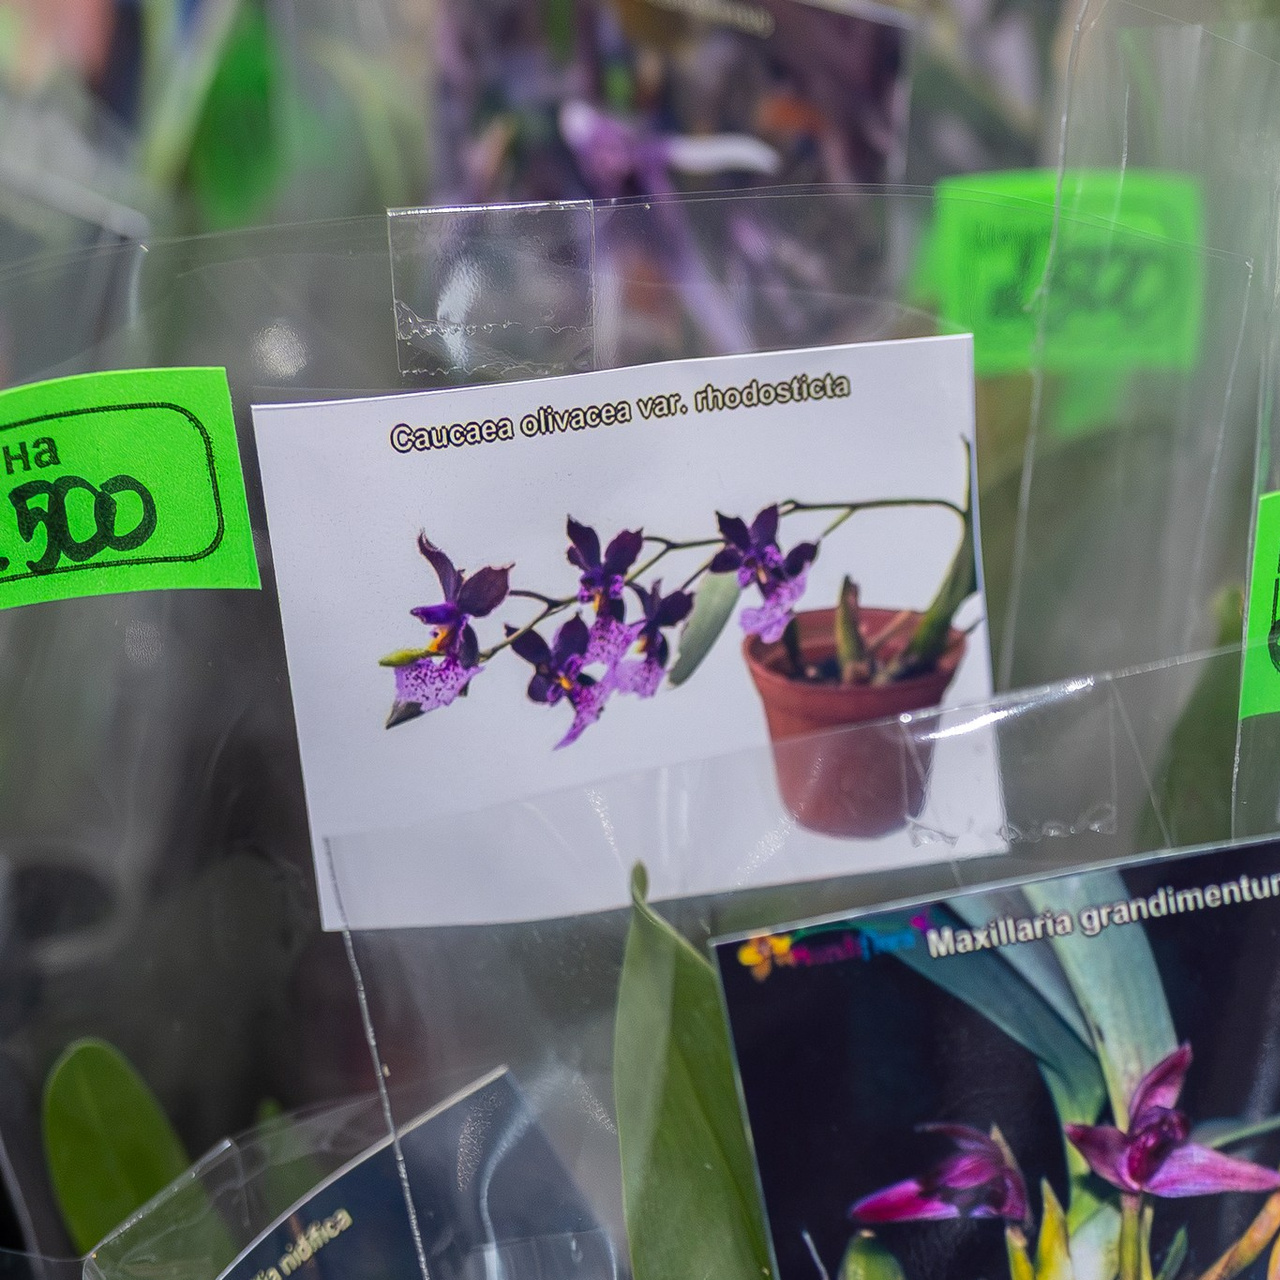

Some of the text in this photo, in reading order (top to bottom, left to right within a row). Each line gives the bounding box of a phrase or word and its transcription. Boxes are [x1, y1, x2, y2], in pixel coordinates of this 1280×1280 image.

[390, 373, 851, 454] Caucaea olivacea var. rhodosticta
[2, 436, 61, 475] на
[0, 474, 158, 573] 500
[926, 908, 1073, 959] Maxillaria
